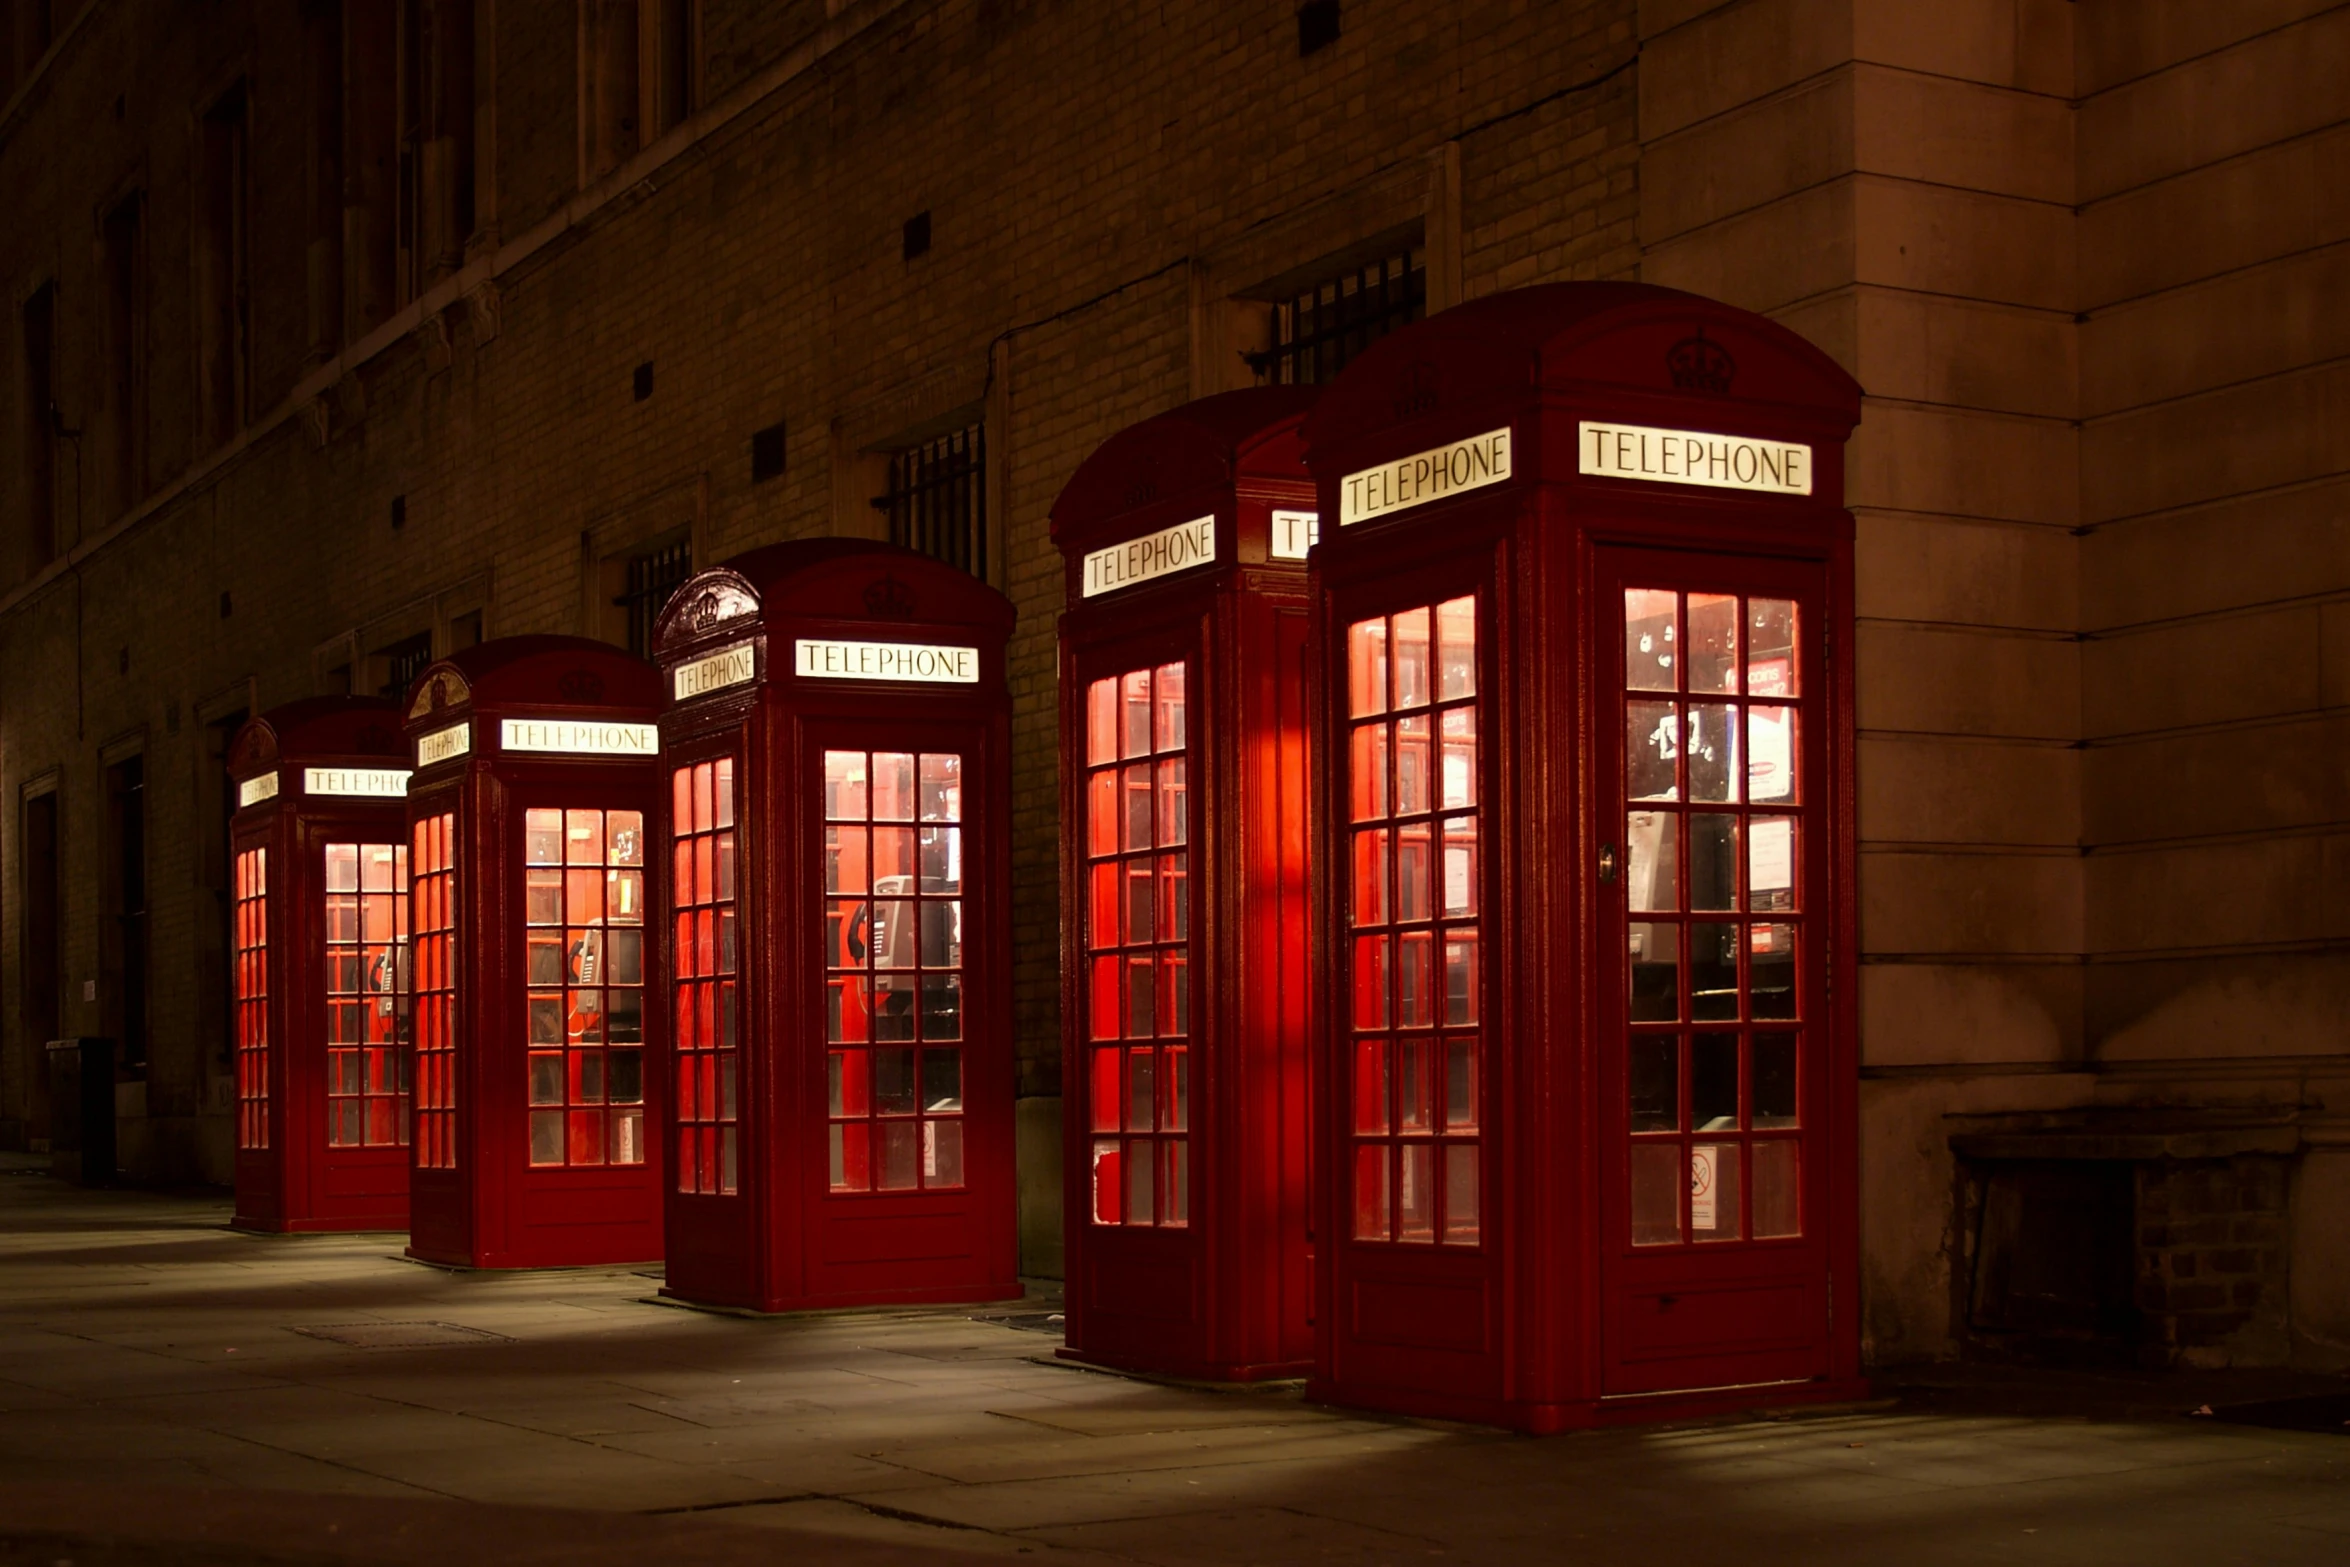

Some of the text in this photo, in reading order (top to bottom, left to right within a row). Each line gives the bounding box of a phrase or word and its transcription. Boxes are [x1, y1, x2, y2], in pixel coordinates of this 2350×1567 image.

[1348, 434, 1506, 515] TELEPHONE
[1587, 429, 1802, 488] TELEPHONE
[1089, 522, 1211, 589] TELEPHONE
[679, 650, 752, 696] TELEPHONE
[802, 645, 970, 677] TELEPHONE
[422, 727, 468, 761] TELEPHONE
[509, 724, 653, 750] TELEPHONE
[311, 772, 408, 792] TELEPHO
